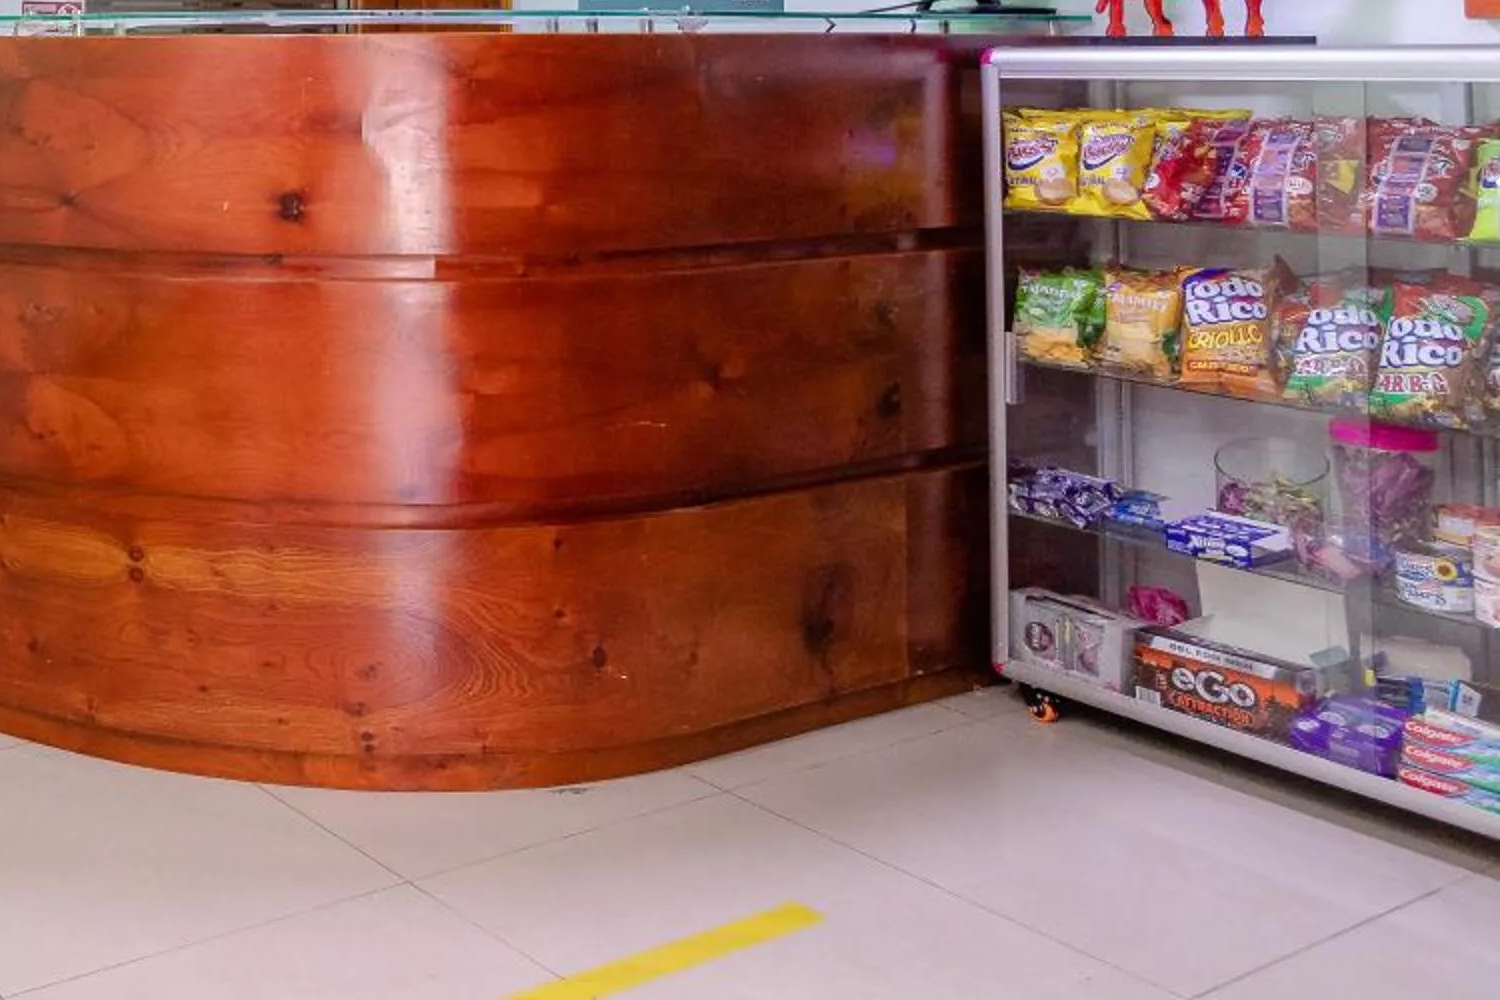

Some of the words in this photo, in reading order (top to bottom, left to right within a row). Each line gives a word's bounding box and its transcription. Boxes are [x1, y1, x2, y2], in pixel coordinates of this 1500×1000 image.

[1185, 296, 1268, 326] Rico
[1308, 304, 1377, 327] odo
[1296, 323, 1379, 353] Rico
[1380, 336, 1463, 368] Rico
[1404, 720, 1464, 746] Colgate
[1404, 745, 1464, 770] Colgate
[1399, 768, 1461, 793] Colgate
